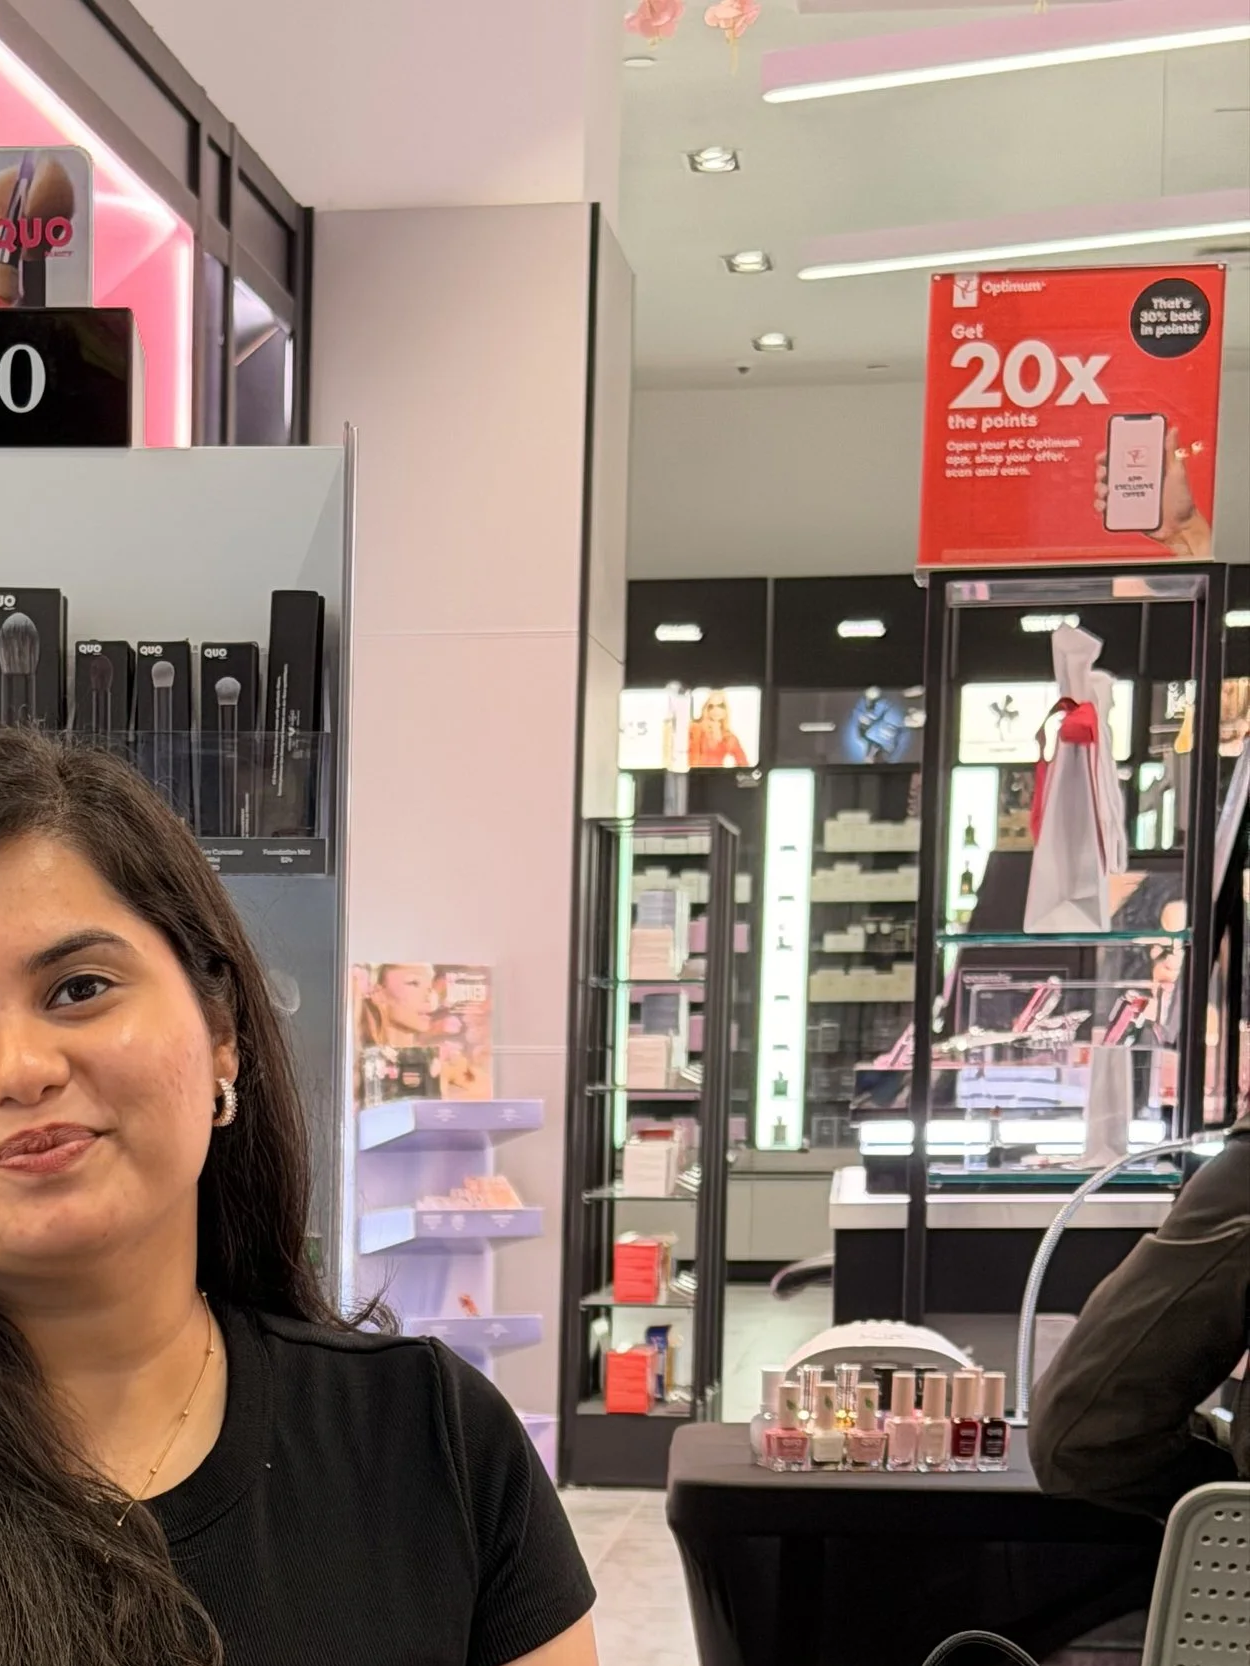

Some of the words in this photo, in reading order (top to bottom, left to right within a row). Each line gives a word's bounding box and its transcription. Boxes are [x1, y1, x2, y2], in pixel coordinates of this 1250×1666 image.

[1170, 308, 1203, 322] back
[951, 322, 984, 340] Get
[1140, 323, 1154, 336] in
[947, 338, 1111, 410] 20x
[947, 414, 977, 430] the
[981, 411, 1038, 434] points
[78, 643, 102, 655] QUO
[139, 645, 163, 656] QUO
[204, 648, 227, 659] QUO
